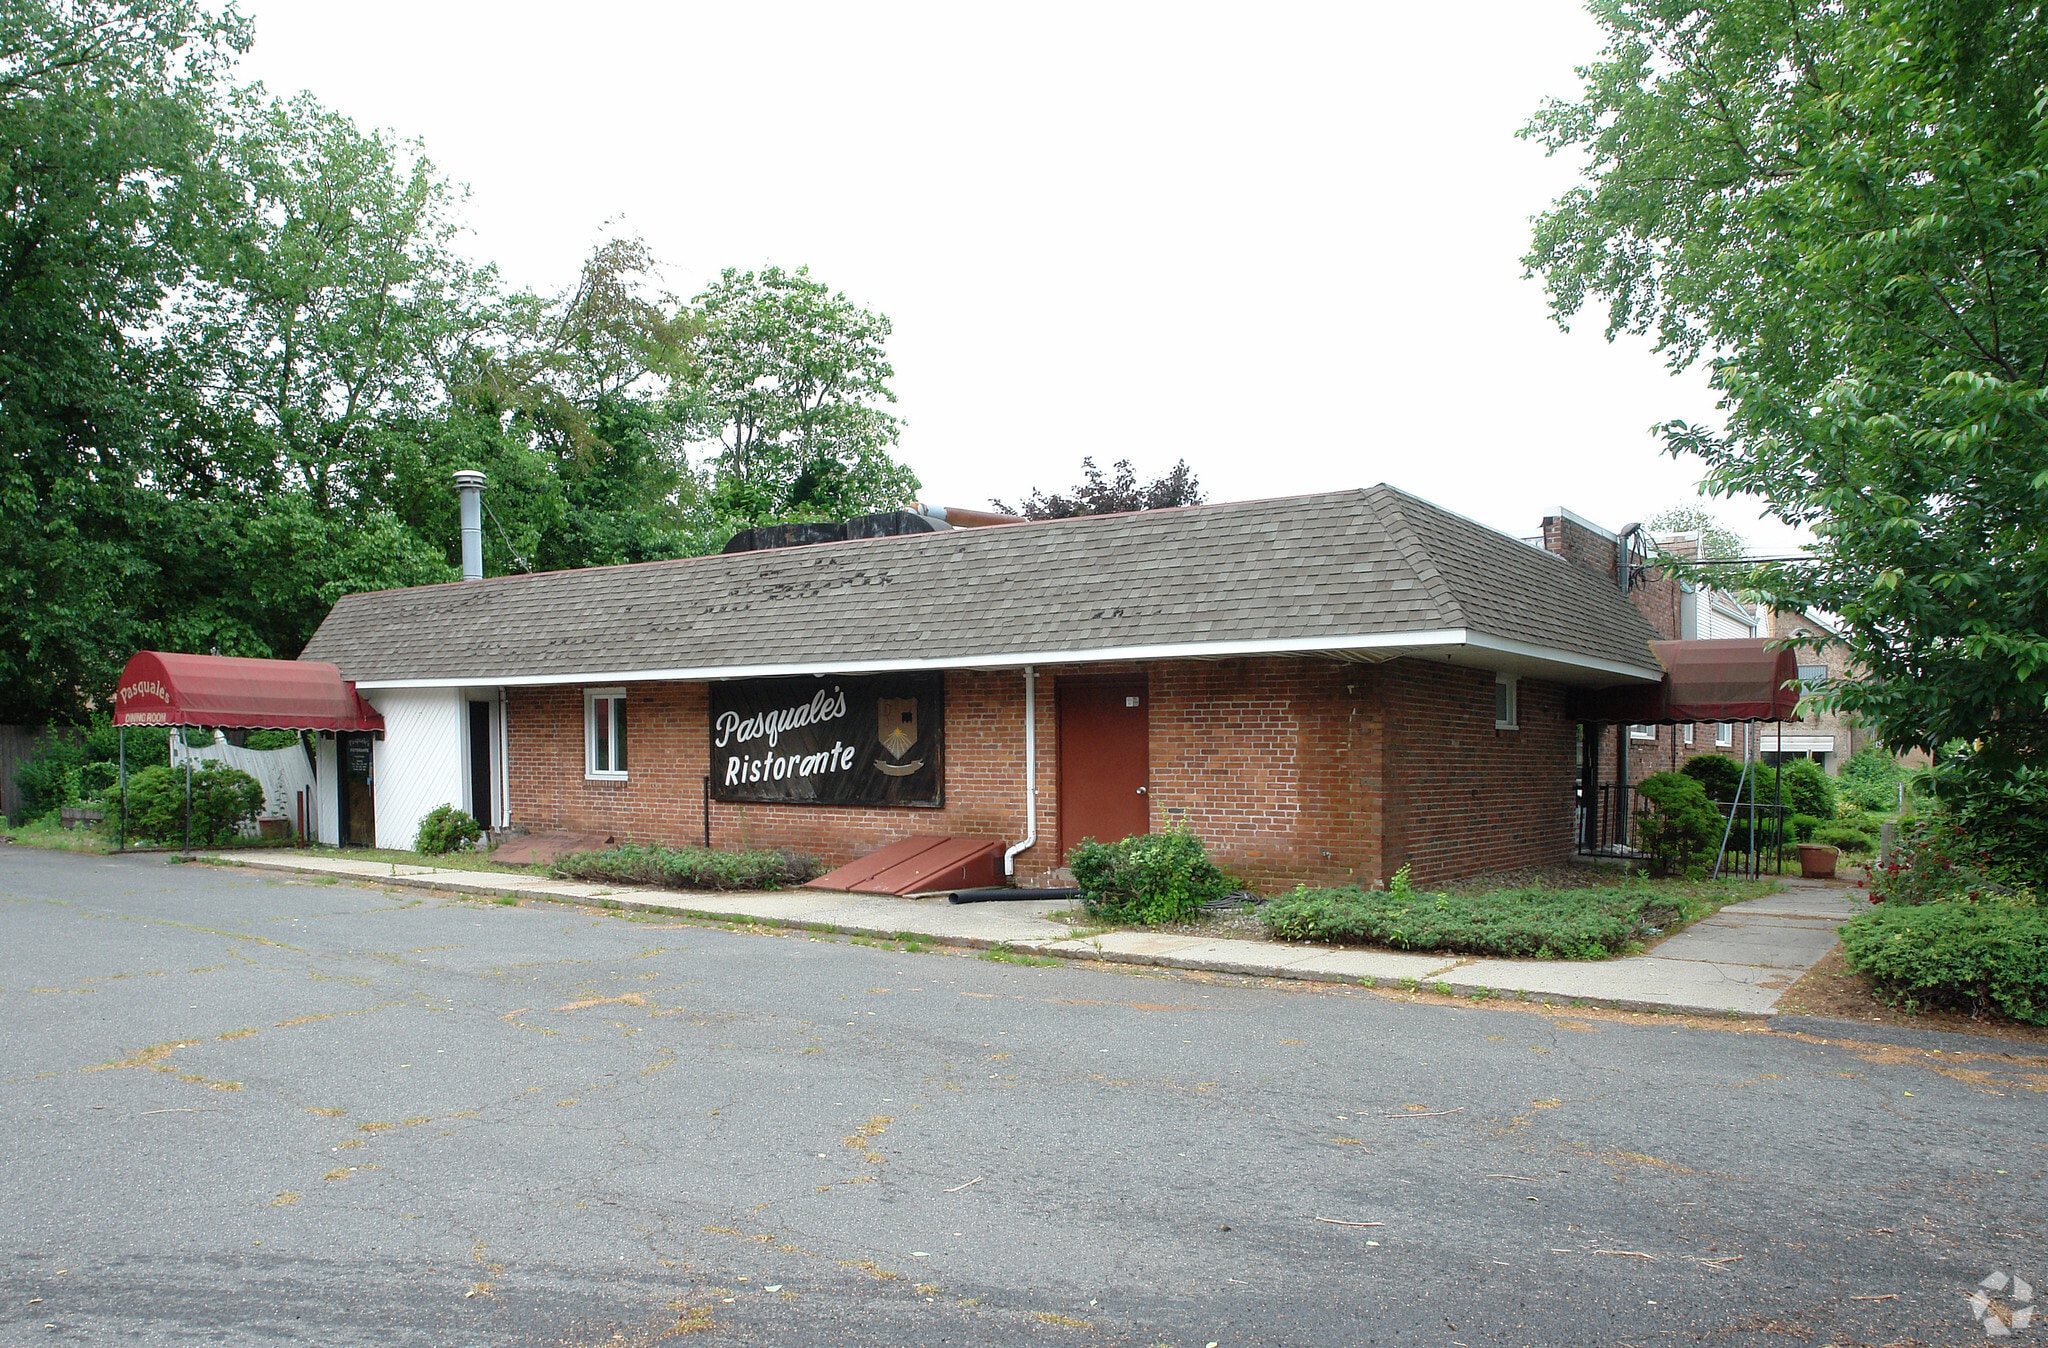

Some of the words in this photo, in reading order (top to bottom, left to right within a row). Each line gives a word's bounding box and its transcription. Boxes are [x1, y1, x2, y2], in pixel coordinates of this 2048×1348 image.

[125, 712, 147, 723] DINING
[147, 712, 167, 722] ROOM
[715, 686, 847, 748] Pasquale's
[725, 741, 856, 786] Ristorante
